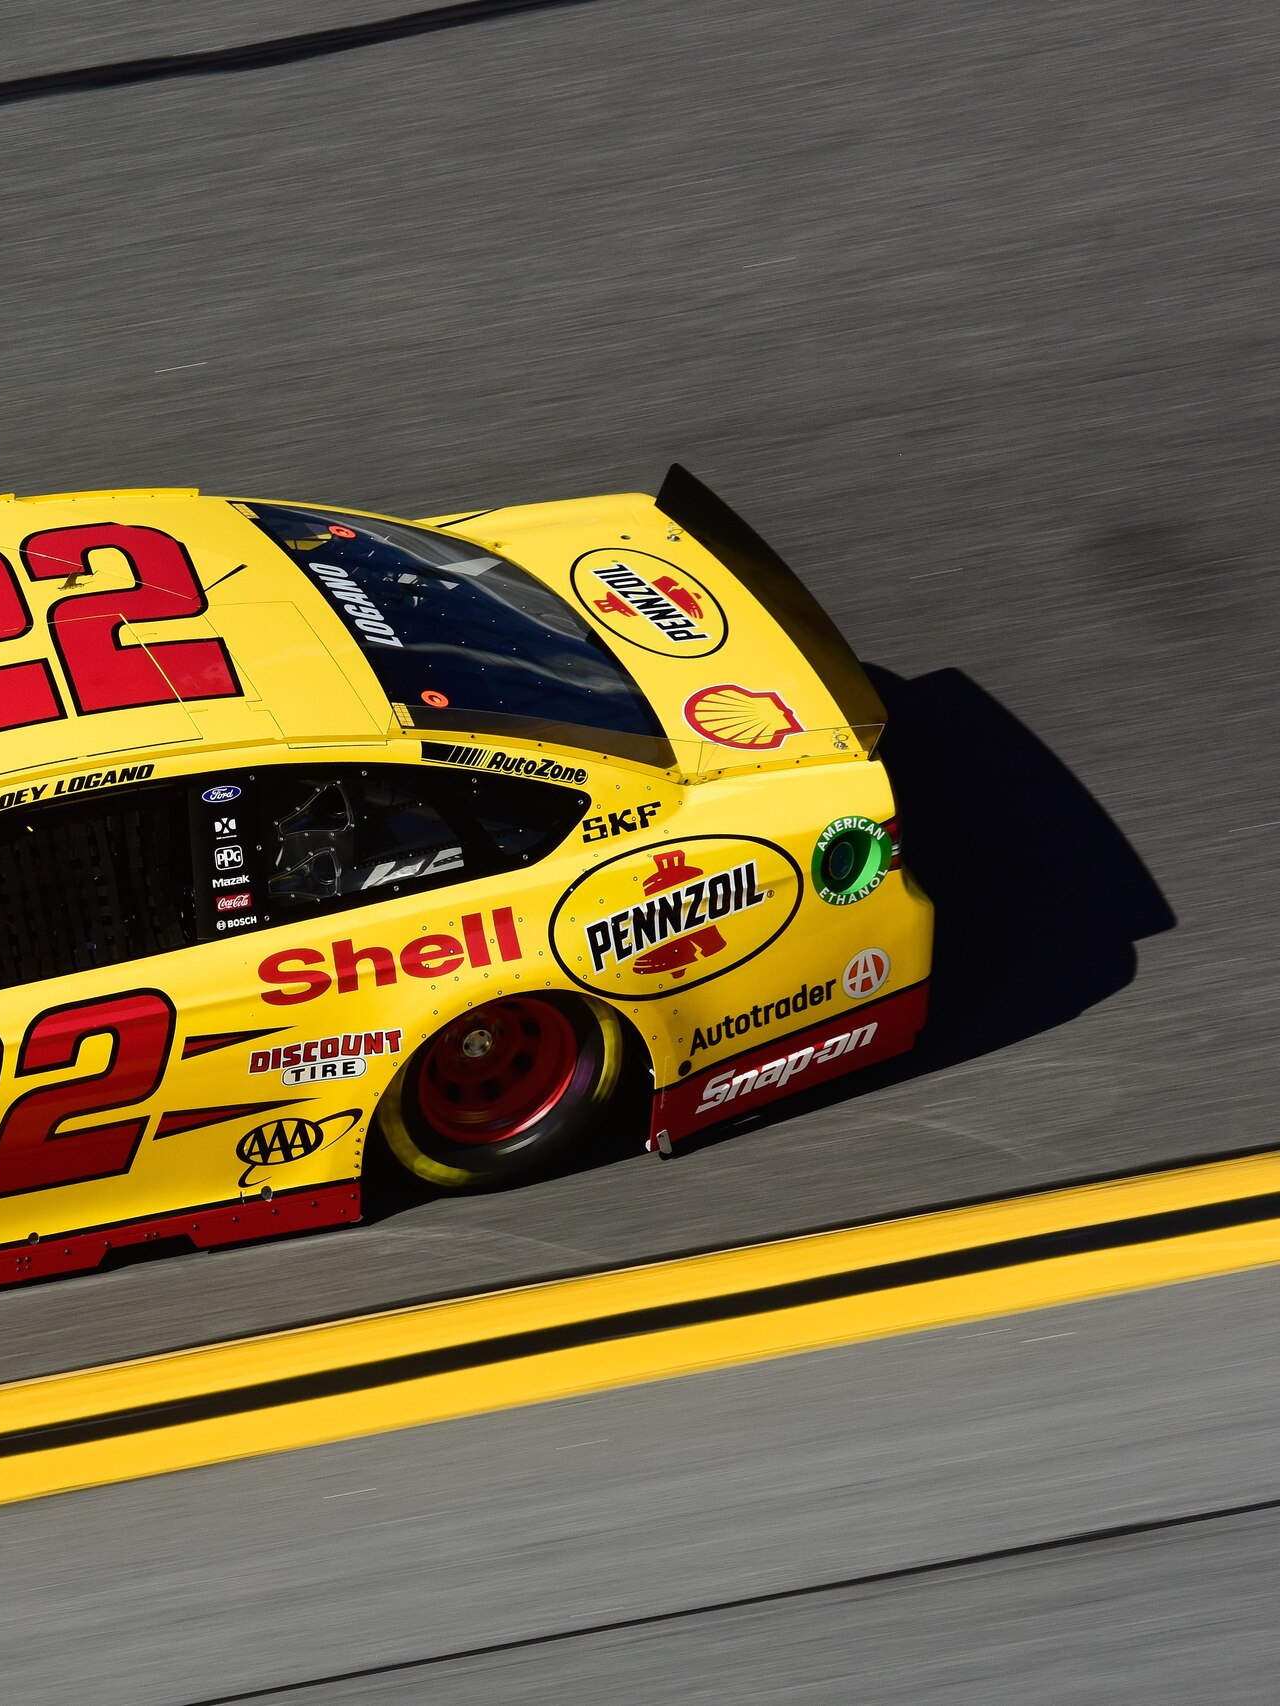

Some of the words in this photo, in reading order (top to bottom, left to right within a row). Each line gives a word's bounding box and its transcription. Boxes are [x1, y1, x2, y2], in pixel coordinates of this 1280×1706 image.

[308, 562, 404, 648] LOGANO
[592, 563, 710, 642] PENNZOIL
[54, 764, 155, 797] LOGANO
[488, 752, 587, 784] AutoZone
[582, 802, 661, 843] SKF
[817, 817, 885, 852] AMERICAN
[212, 875, 250, 888] Mazak
[819, 869, 888, 905] ETHANOL
[227, 916, 257, 928] BOSCH
[585, 860, 766, 974] PENNZOIL
[258, 907, 522, 1006] Shell
[690, 978, 836, 1056] Autotrader
[249, 1030, 403, 1074] DISCOUNT
[291, 1061, 357, 1083] TIRE
